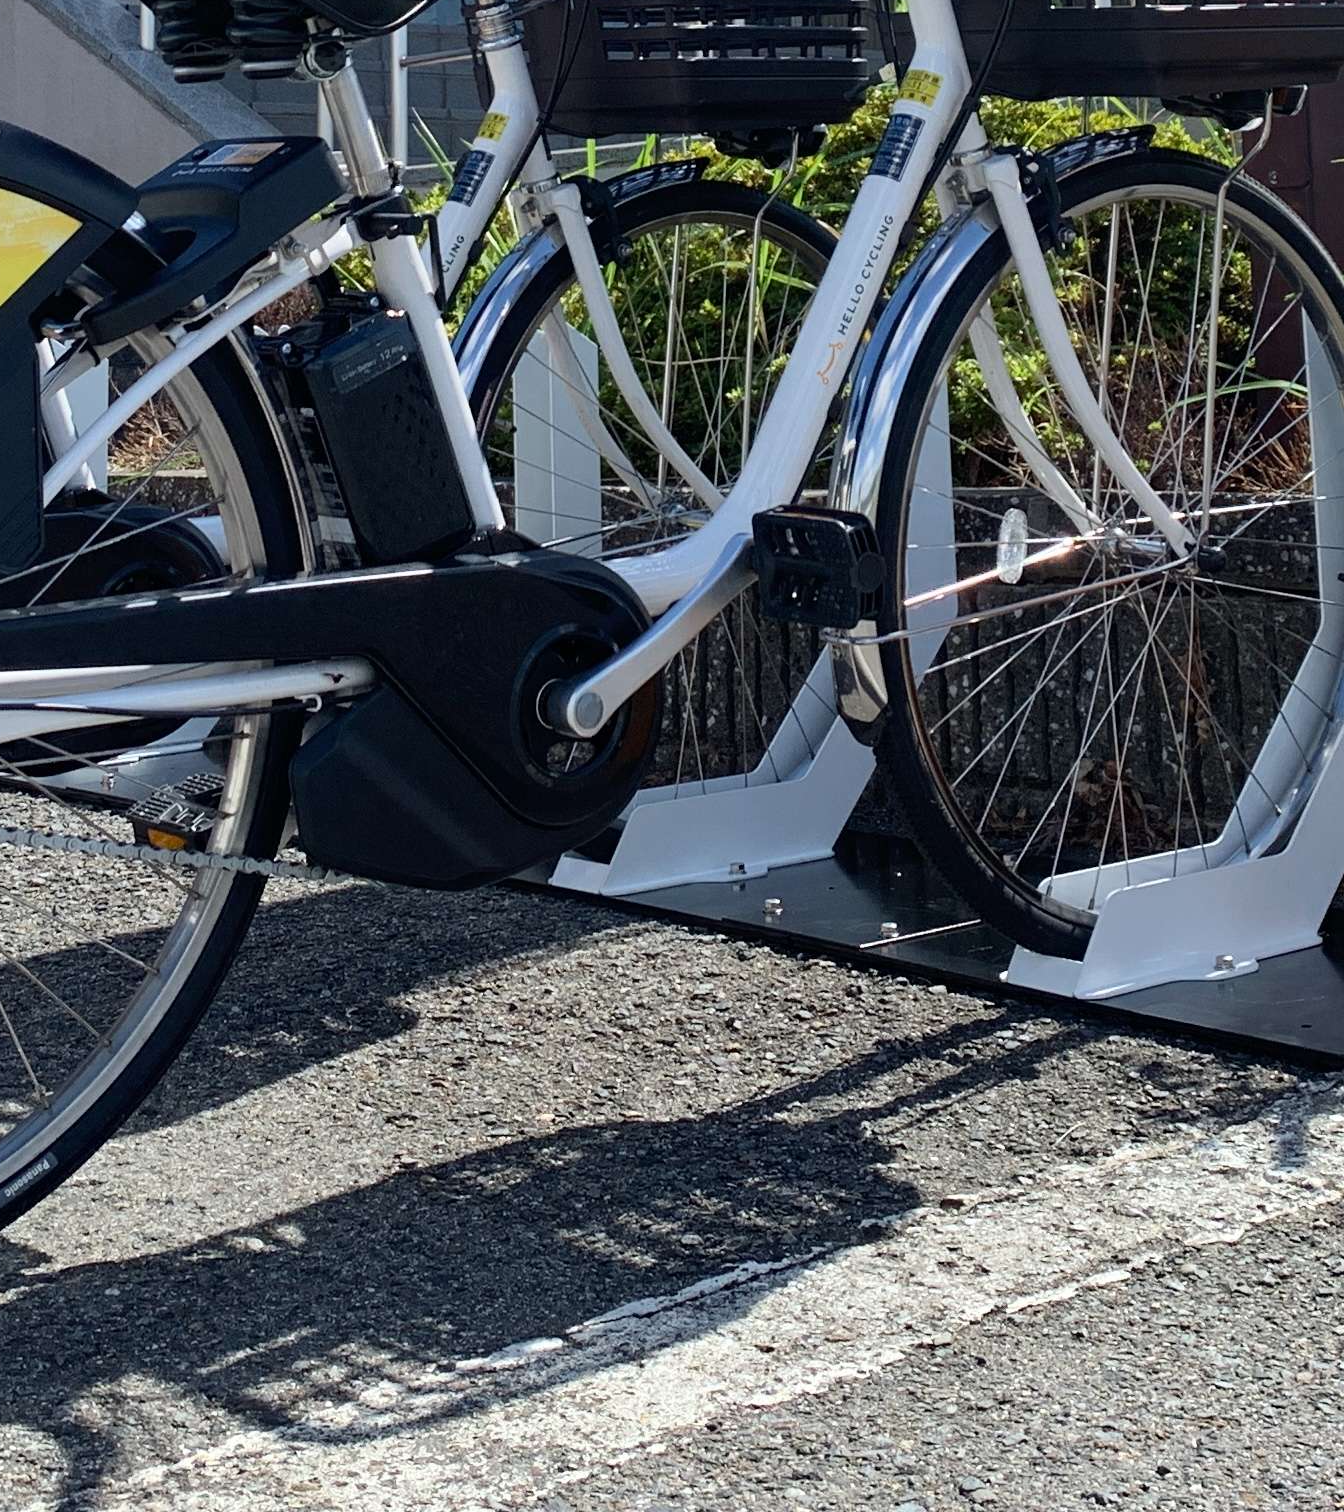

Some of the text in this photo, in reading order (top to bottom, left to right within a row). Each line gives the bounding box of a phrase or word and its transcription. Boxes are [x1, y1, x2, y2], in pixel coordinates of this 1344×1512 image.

[837, 214, 894, 336] HELLO CYCLING
[4, 1158, 51, 1198] Panasonic
